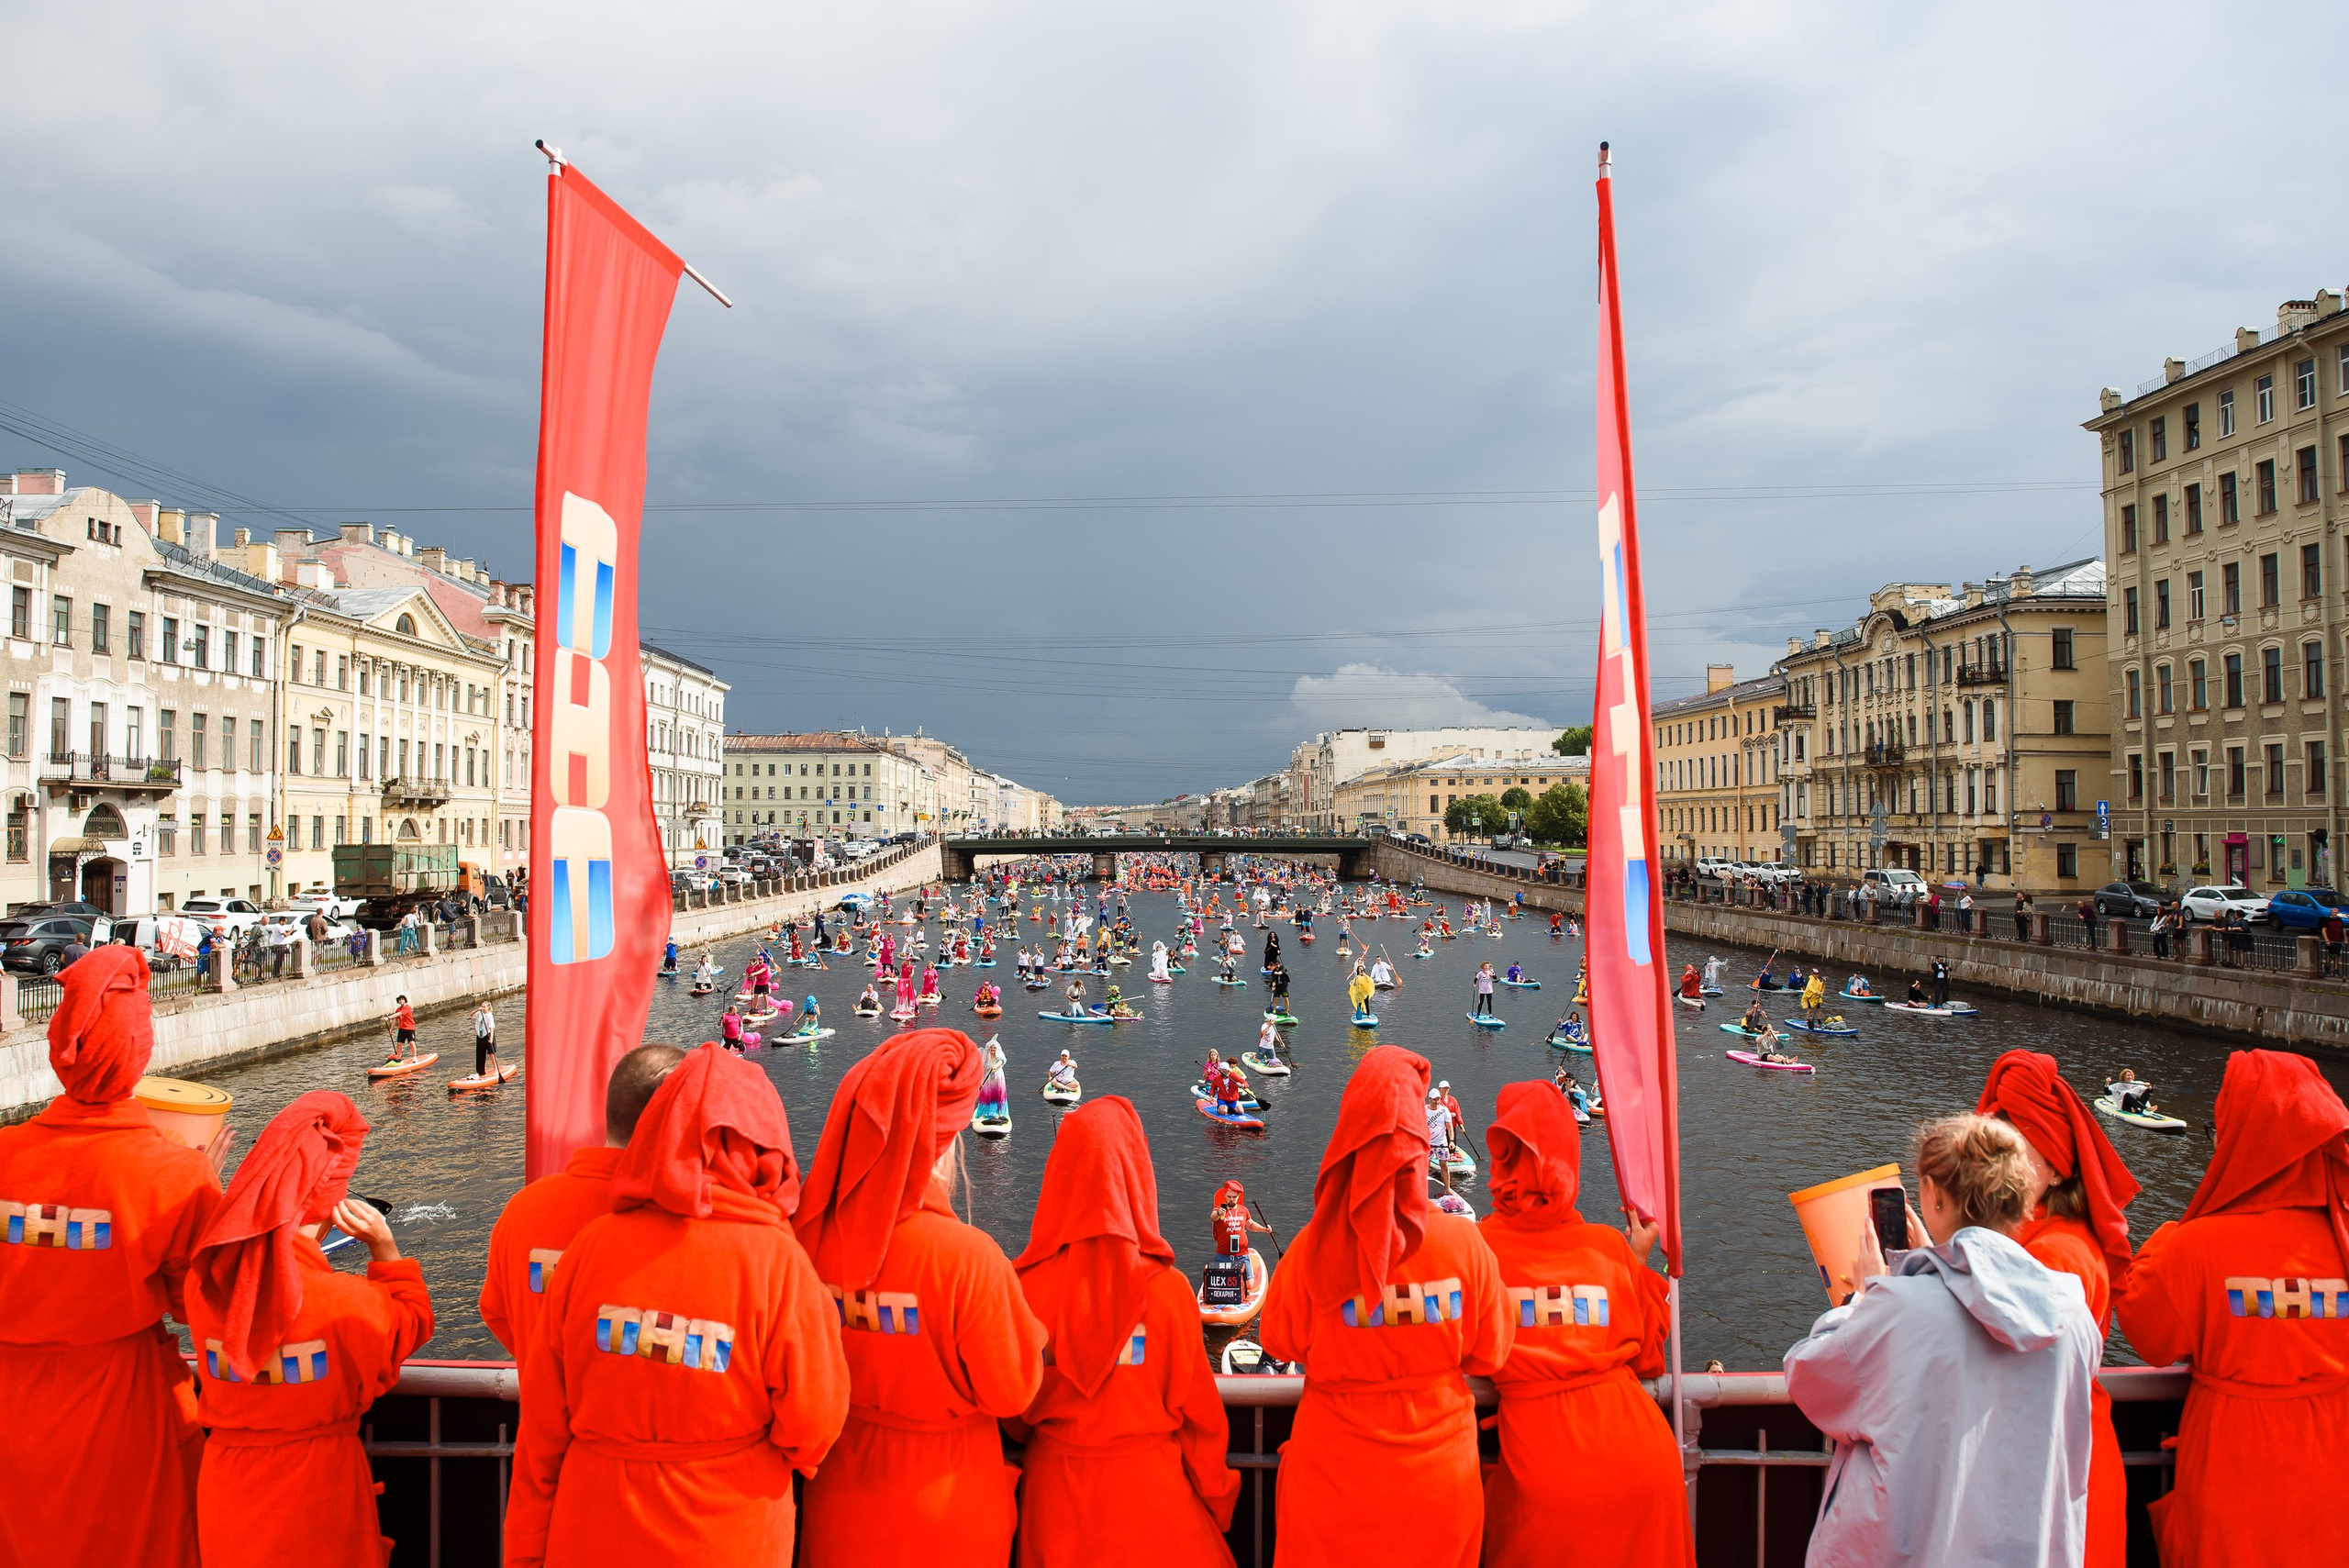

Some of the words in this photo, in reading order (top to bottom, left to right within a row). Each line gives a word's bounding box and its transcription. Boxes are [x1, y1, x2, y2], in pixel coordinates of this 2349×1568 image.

[551, 490, 618, 965] ТНТ
[1210, 1275, 1227, 1287] ЦЕХ
[1227, 1276, 1238, 1287] 85
[1213, 1290, 1234, 1298] ПЕКАРНЯ
[2224, 1276, 2349, 1319] ТНТ
[827, 1283, 919, 1336] НТ
[596, 1303, 736, 1373] ТНТ
